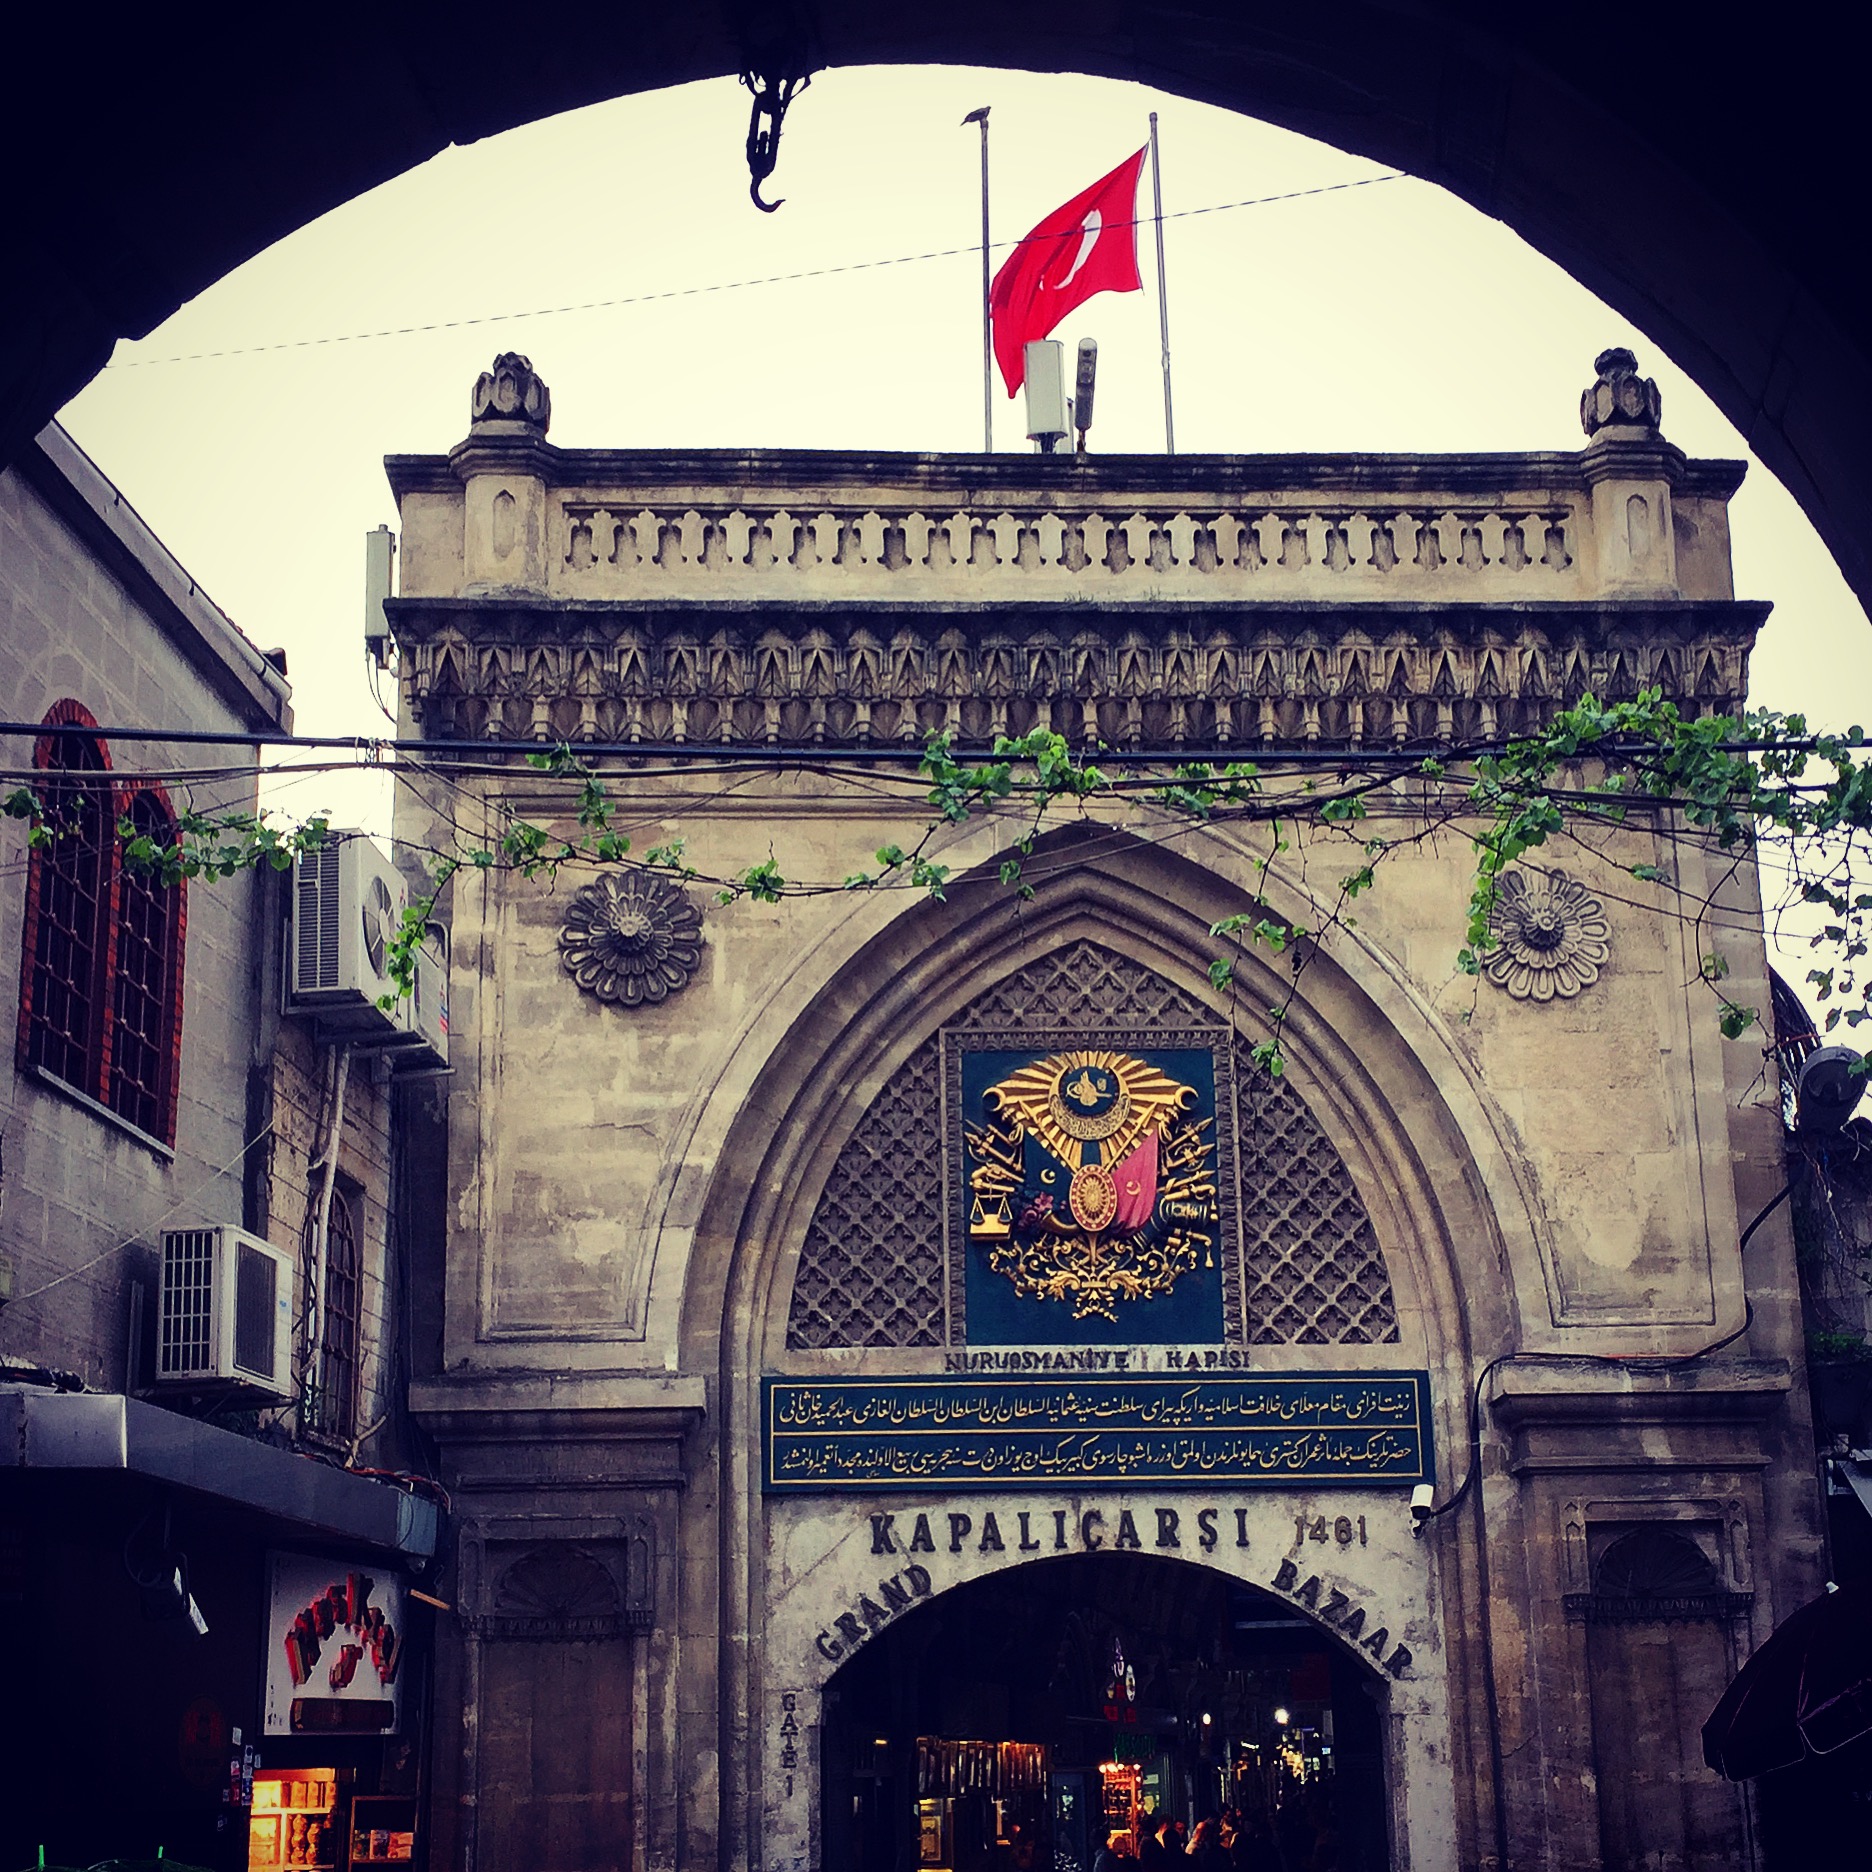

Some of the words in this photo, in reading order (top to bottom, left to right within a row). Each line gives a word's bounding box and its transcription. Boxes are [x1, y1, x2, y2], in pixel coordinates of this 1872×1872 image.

[870, 1508, 1250, 1554] KAPALIÇARŞI
[1296, 1515, 1368, 1544] 1461
[815, 1563, 932, 1662] GRAND
[1271, 1557, 1414, 1680] BAZAAR
[780, 1692, 799, 1769] GATE
